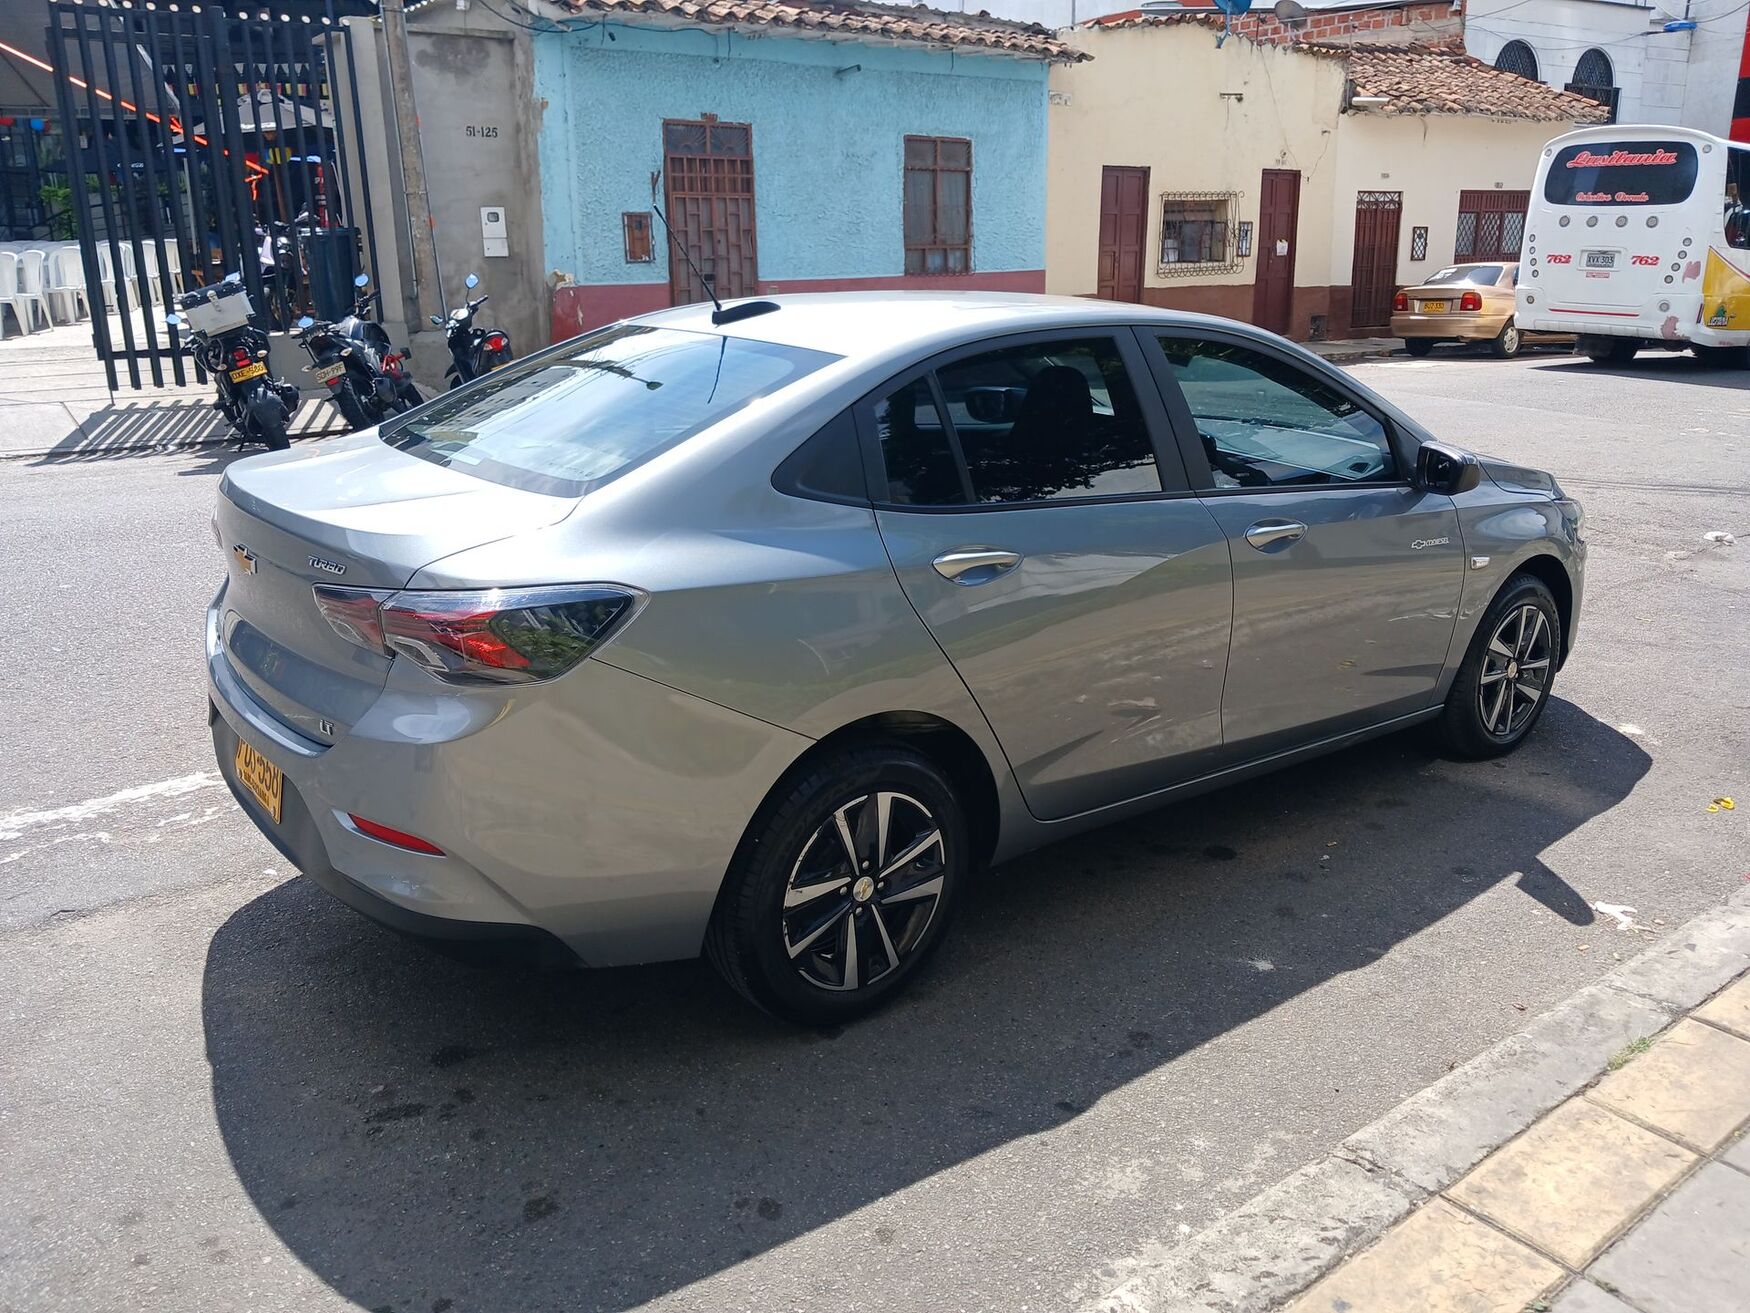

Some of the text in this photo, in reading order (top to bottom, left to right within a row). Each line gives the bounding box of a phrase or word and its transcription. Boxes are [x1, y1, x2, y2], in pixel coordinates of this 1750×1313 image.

[465, 125, 498, 138] 51-125
[1546, 254, 1572, 264] 762
[1631, 255, 1660, 266] 762
[308, 555, 346, 575] TURBO
[320, 719, 334, 735] LT
